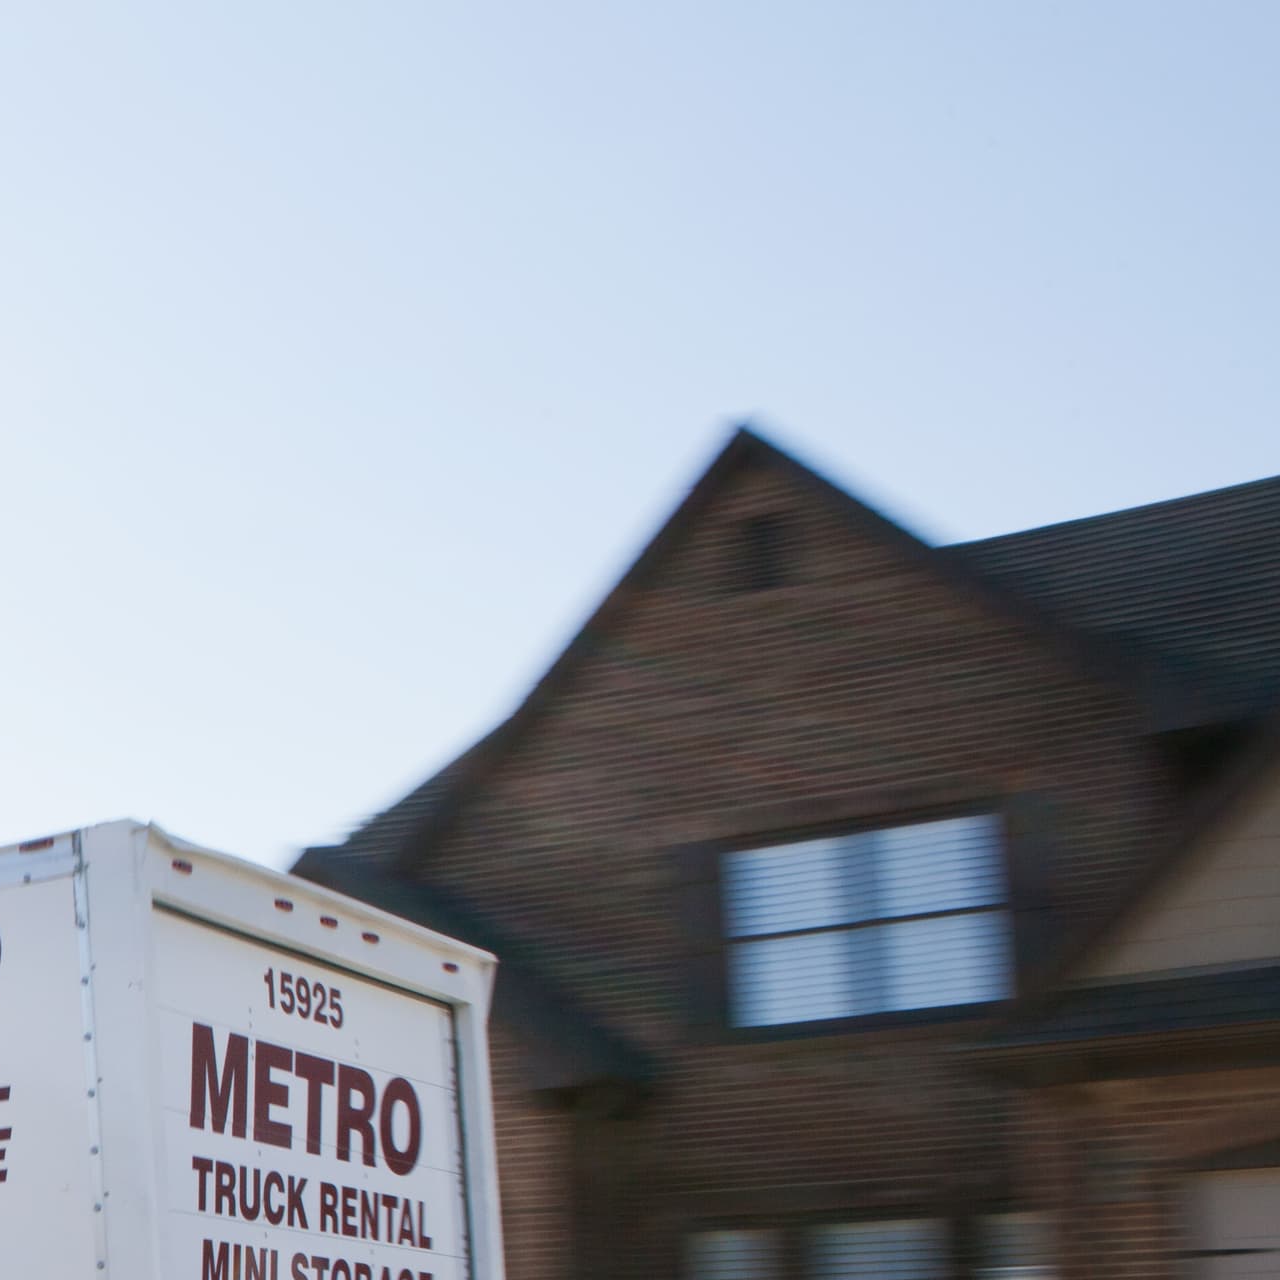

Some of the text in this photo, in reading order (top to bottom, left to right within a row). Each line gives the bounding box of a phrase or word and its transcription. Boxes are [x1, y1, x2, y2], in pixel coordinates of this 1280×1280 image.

[264, 967, 344, 1029] 15925
[189, 1021, 422, 1176] METRO
[192, 1156, 434, 1250] TRUCK RENTAL
